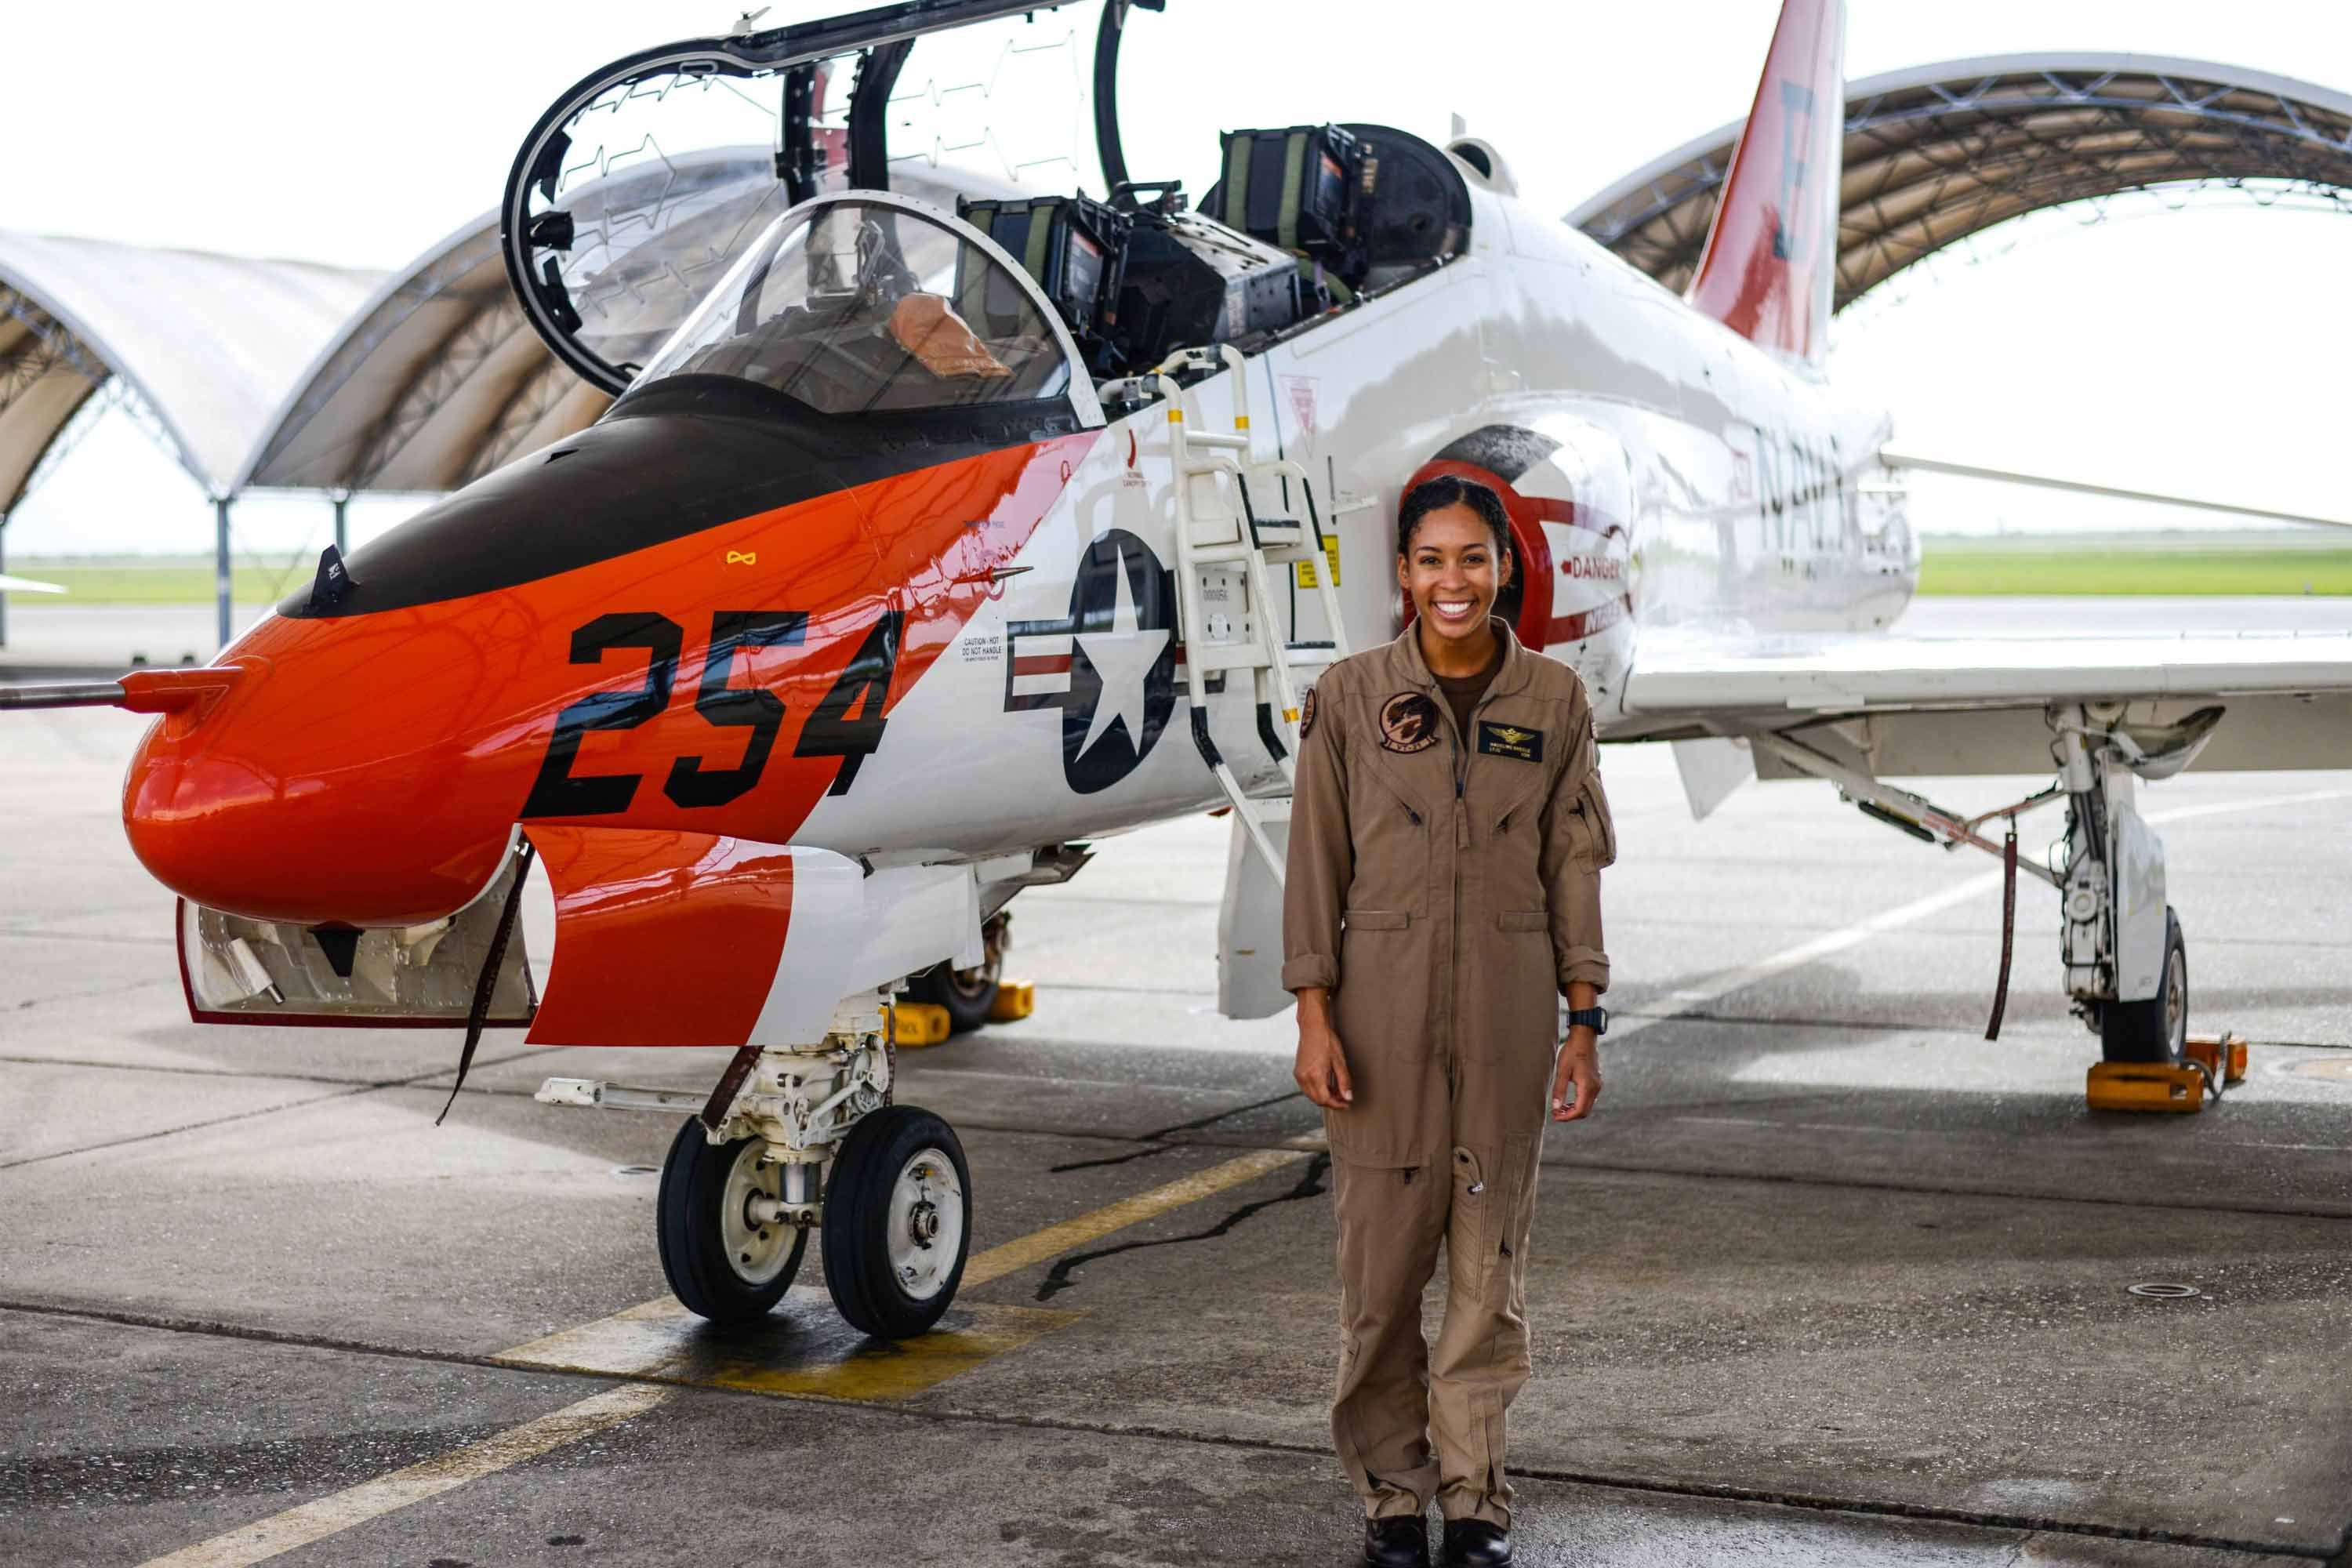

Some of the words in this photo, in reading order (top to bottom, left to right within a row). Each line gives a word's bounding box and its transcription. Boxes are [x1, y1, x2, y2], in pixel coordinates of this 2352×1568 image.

[964, 637, 986, 646] CAUTION
[989, 636, 1000, 644] HOT
[962, 648, 970, 656] DO
[971, 646, 981, 655] NOT
[982, 645, 1002, 655] HANDLE
[519, 611, 905, 818] 254
